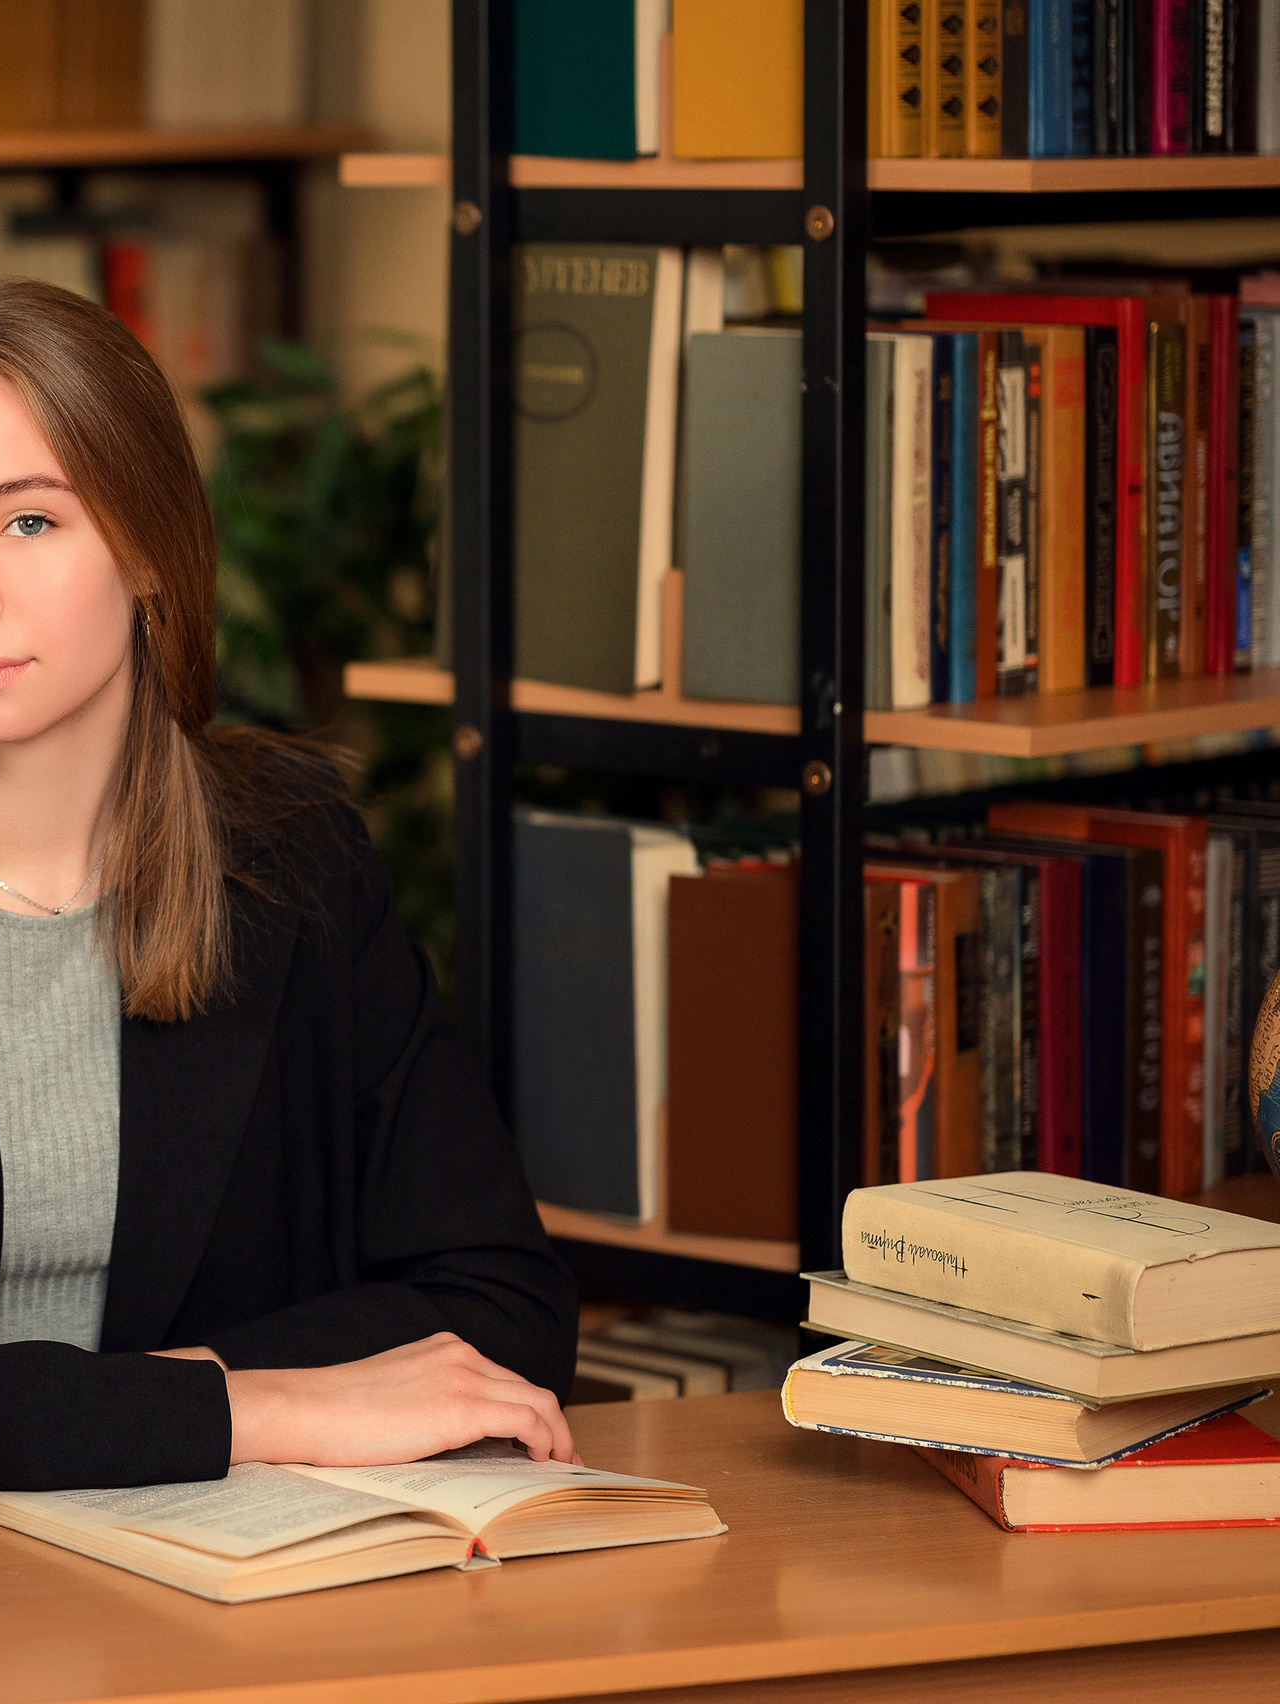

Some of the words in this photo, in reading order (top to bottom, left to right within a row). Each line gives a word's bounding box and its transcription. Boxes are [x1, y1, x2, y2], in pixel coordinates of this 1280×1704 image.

[1157, 411, 1184, 622] АВИАТОР
[860, 1229, 906, 1264] Вирта
[907, 1242, 969, 1279] Николай
